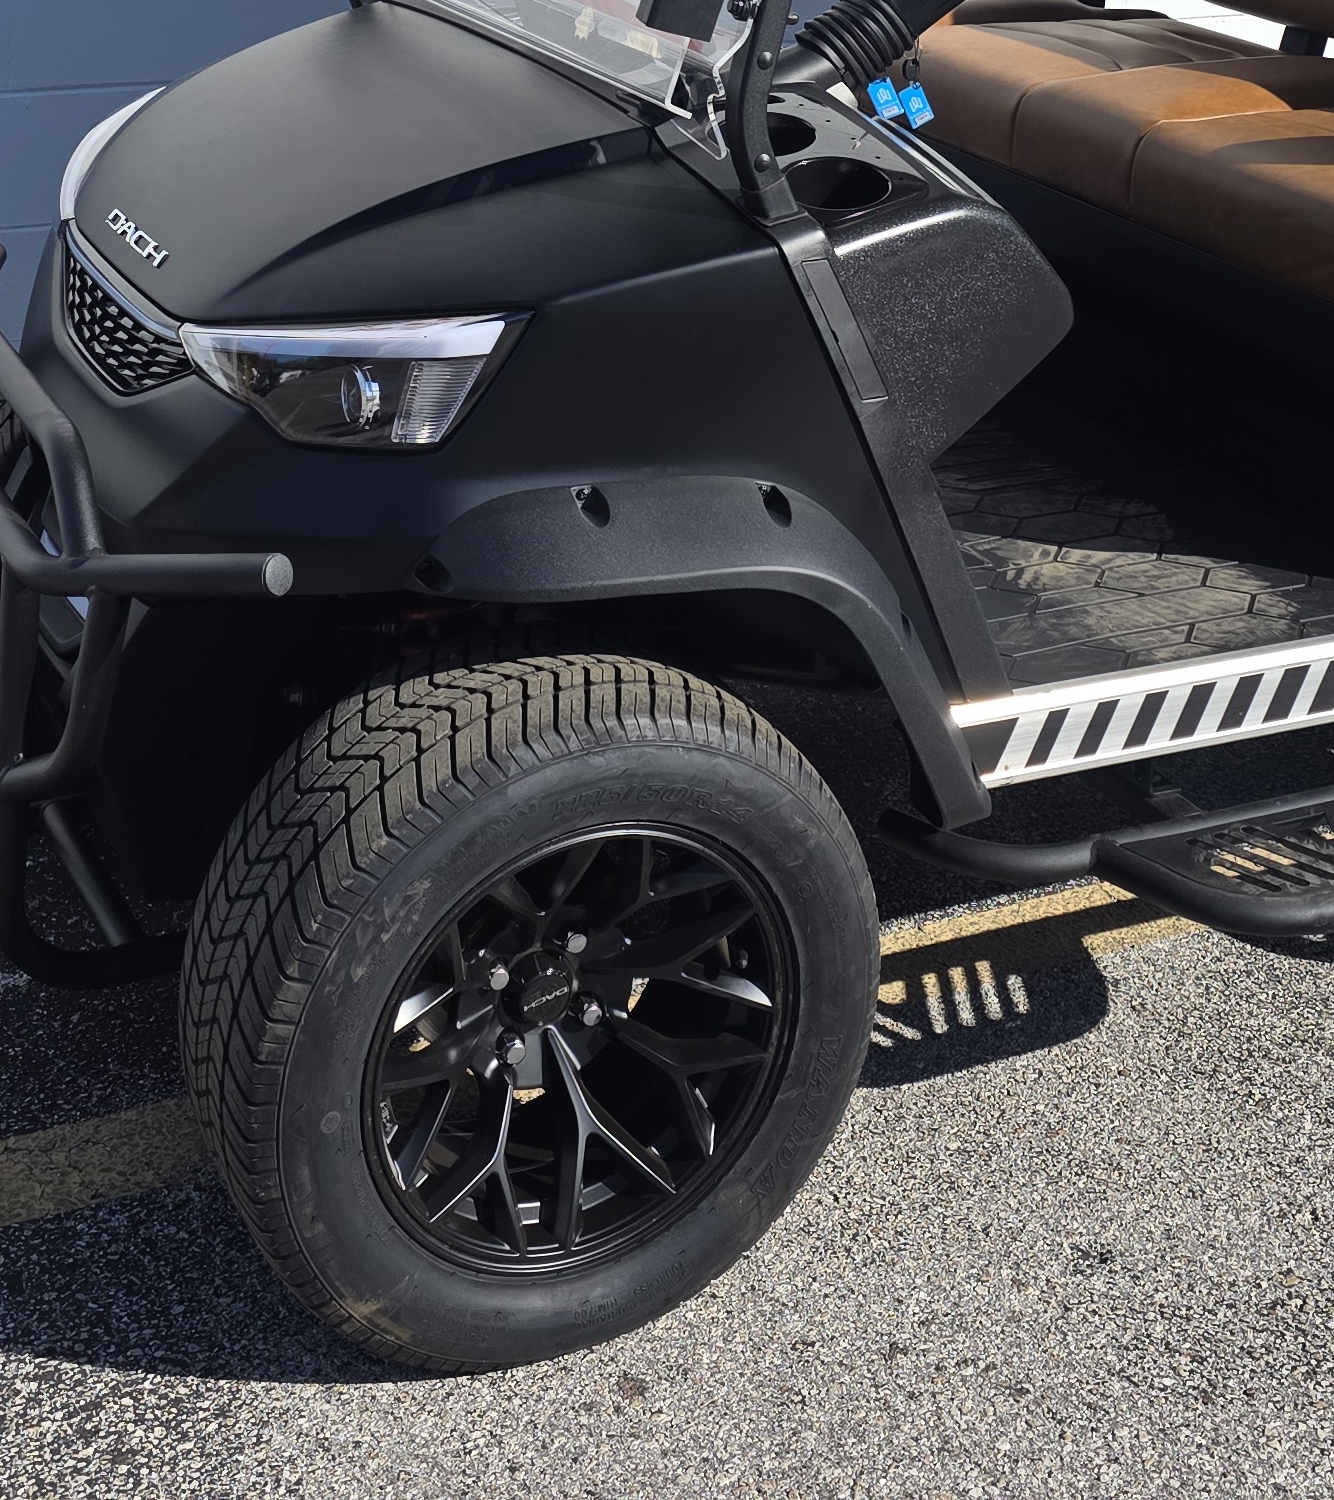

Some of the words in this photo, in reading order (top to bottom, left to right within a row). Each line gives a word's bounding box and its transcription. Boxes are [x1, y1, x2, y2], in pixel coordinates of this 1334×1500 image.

[106, 207, 170, 269] DACH
[523, 986, 568, 1012] DACH
[751, 1035, 845, 1197] WANDA
